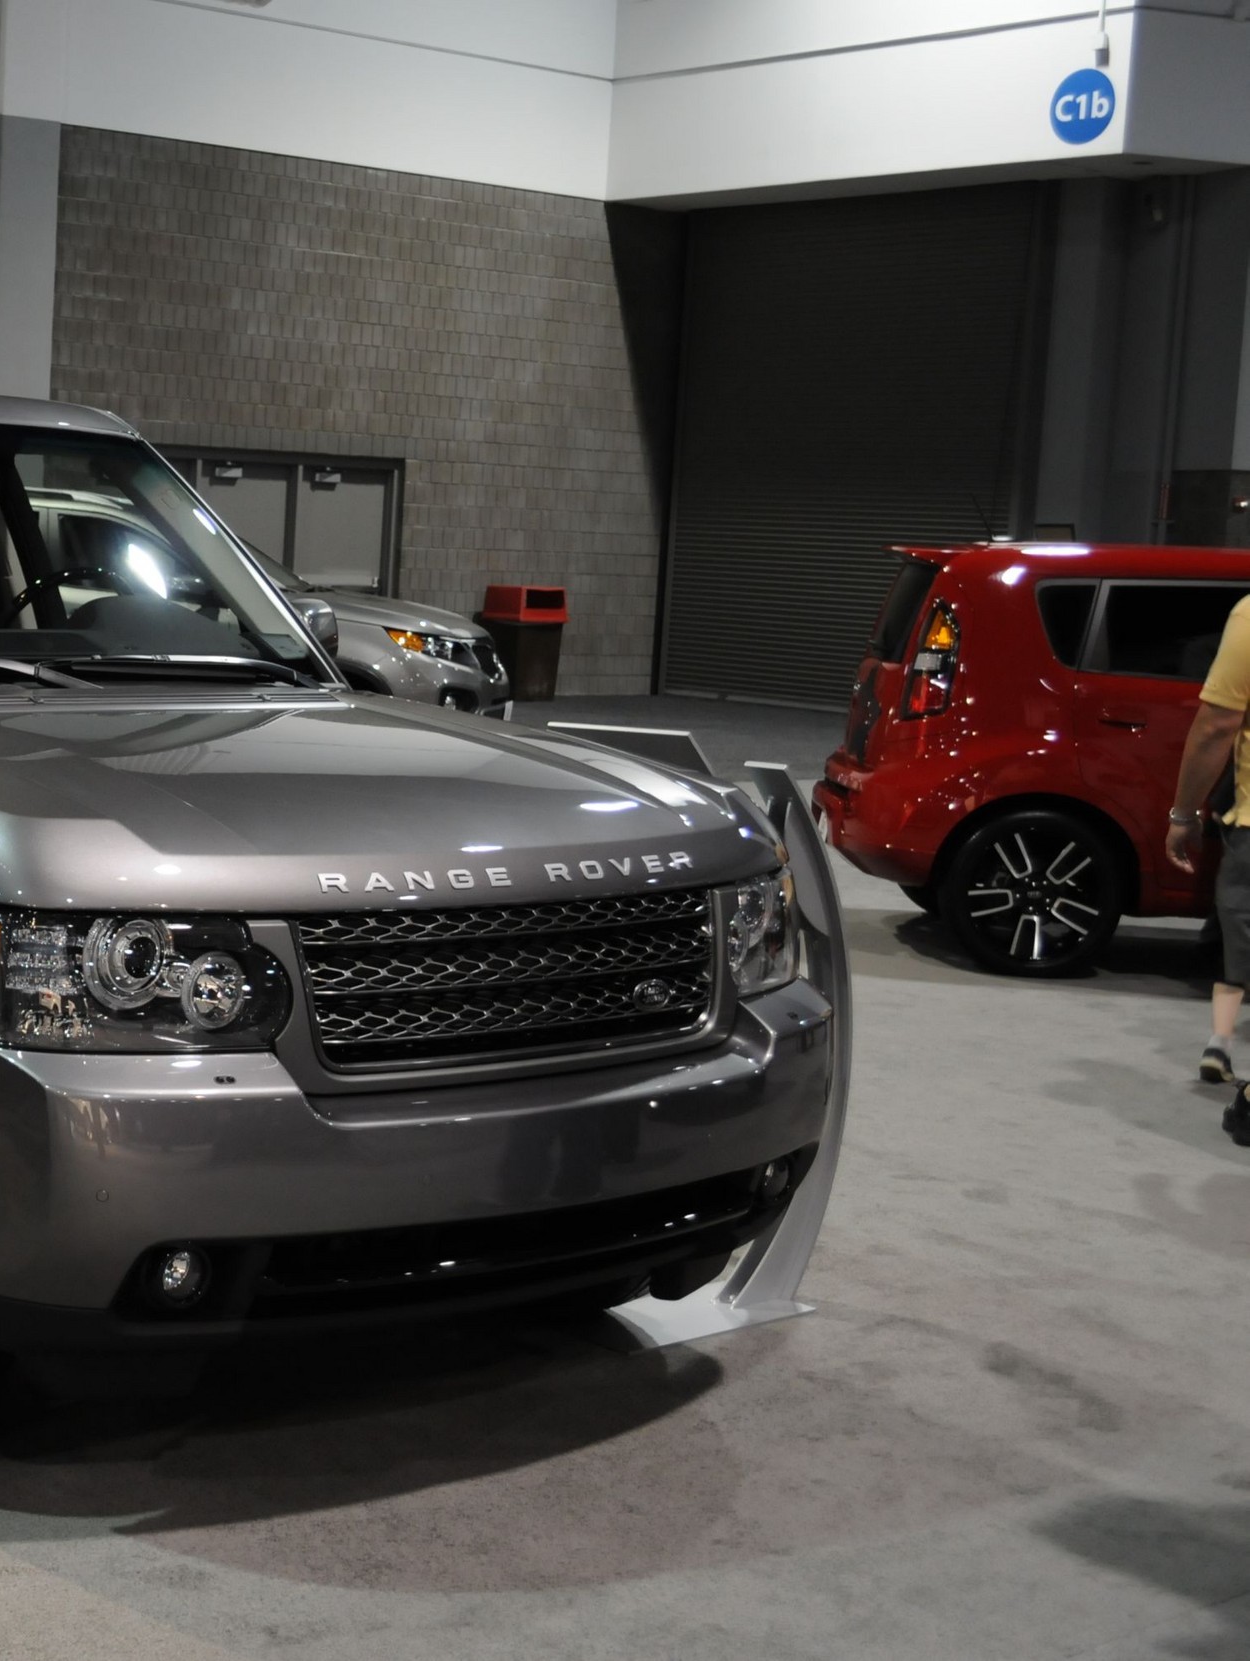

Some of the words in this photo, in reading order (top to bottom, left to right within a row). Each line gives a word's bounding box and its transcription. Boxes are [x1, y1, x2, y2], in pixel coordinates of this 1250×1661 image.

[1055, 90, 1110, 122] C1b
[317, 866, 512, 894] RANGE
[543, 850, 693, 884] ROVER
